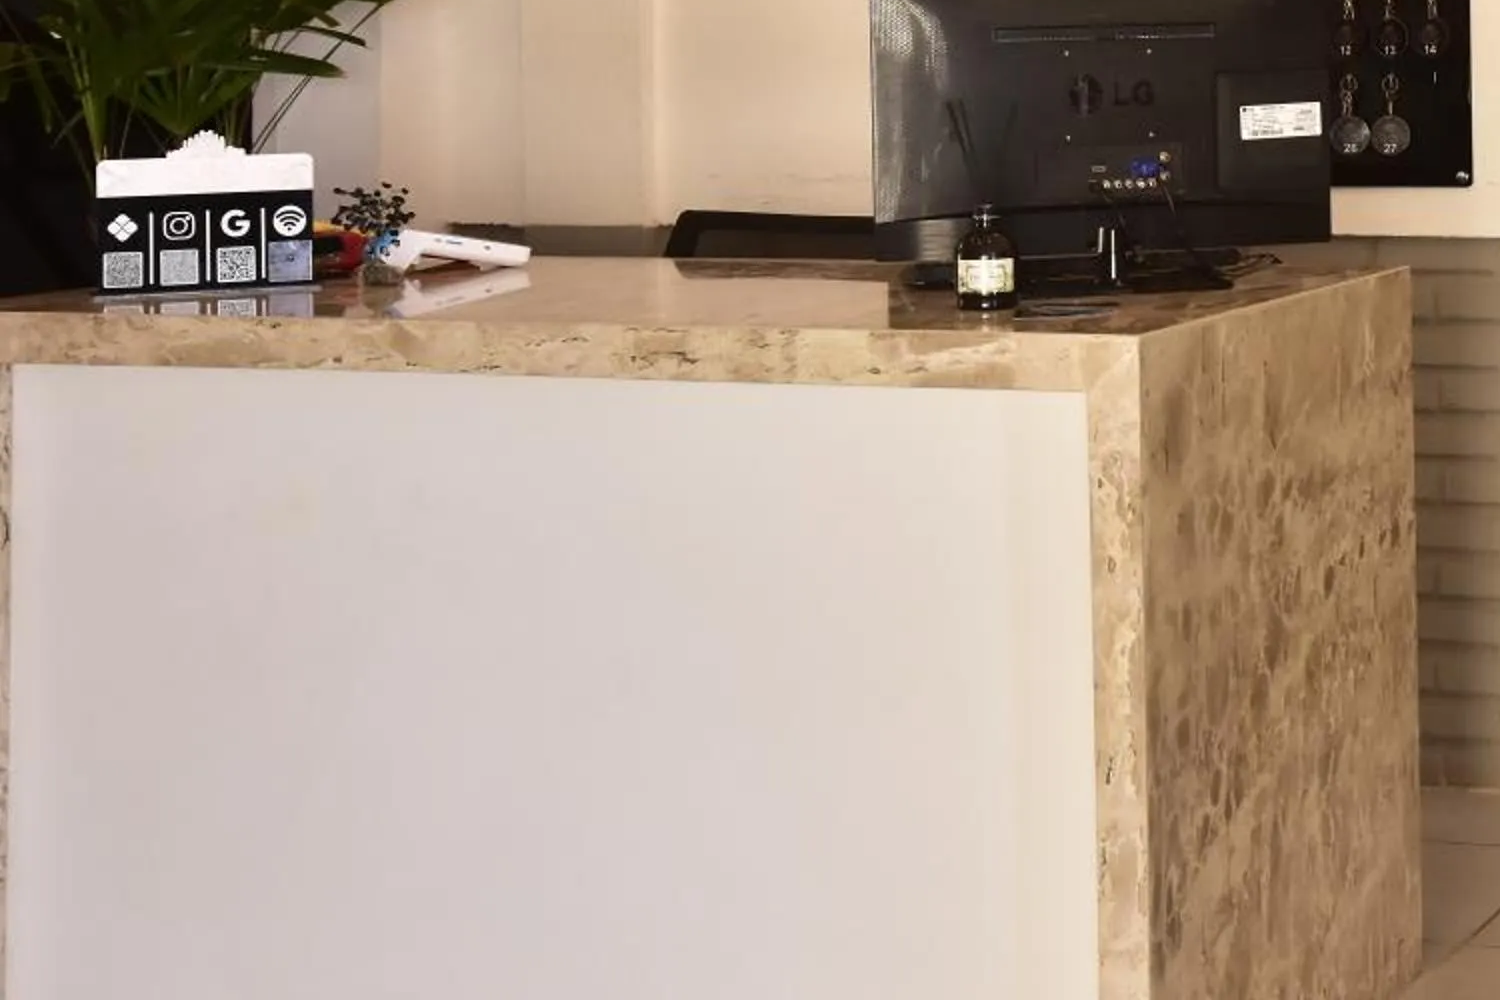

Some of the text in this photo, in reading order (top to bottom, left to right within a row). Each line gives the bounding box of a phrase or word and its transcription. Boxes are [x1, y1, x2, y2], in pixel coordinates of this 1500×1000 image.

[1113, 79, 1155, 106] LG
[1383, 142, 1397, 154] 27
[220, 208, 251, 238] G
